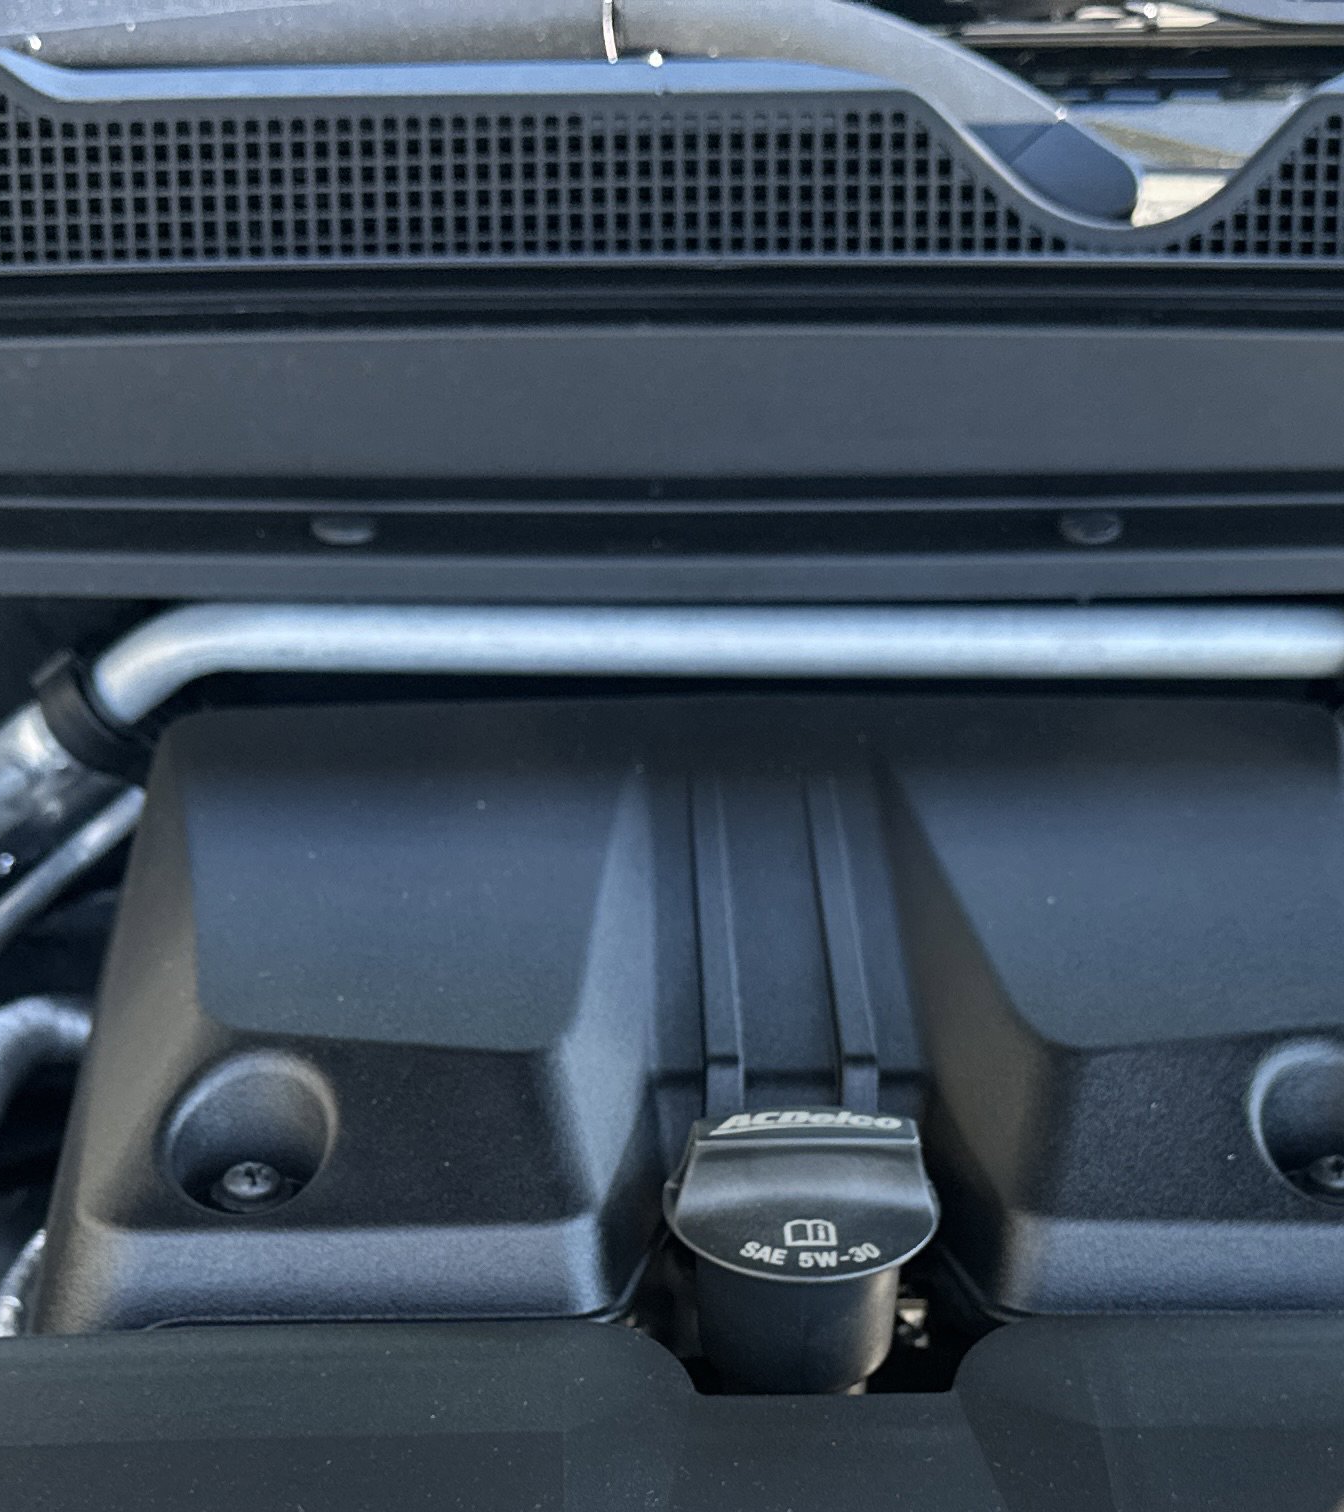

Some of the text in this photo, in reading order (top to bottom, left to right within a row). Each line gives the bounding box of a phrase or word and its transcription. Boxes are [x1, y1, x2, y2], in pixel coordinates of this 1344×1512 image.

[712, 1110, 903, 1133] ACDelco
[739, 1240, 881, 1269] SAE 5W-30
